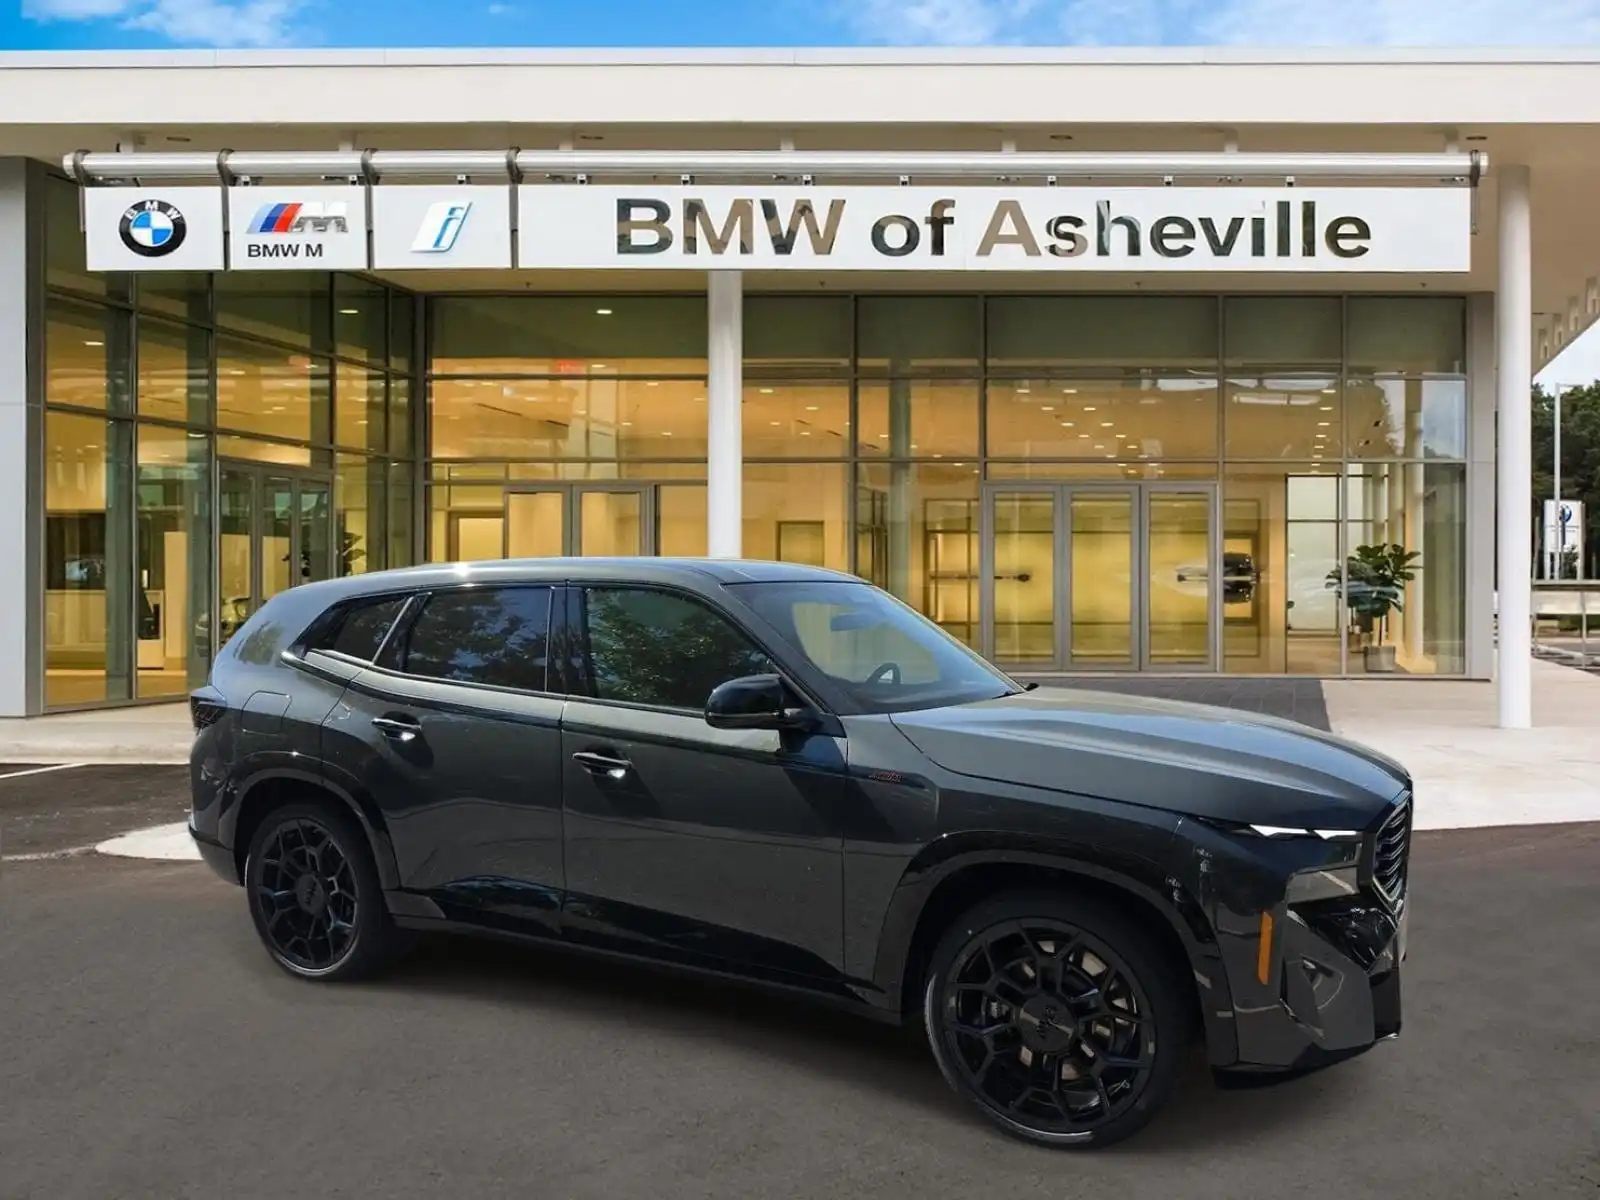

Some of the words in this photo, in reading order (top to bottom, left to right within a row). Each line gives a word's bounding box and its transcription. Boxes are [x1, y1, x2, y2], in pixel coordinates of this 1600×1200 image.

[124, 200, 181, 220] BMW
[617, 198, 847, 256] BMW
[870, 199, 957, 257] of
[976, 199, 1372, 259] Asheville
[247, 243, 300, 258] BMW
[304, 243, 324, 258] M
